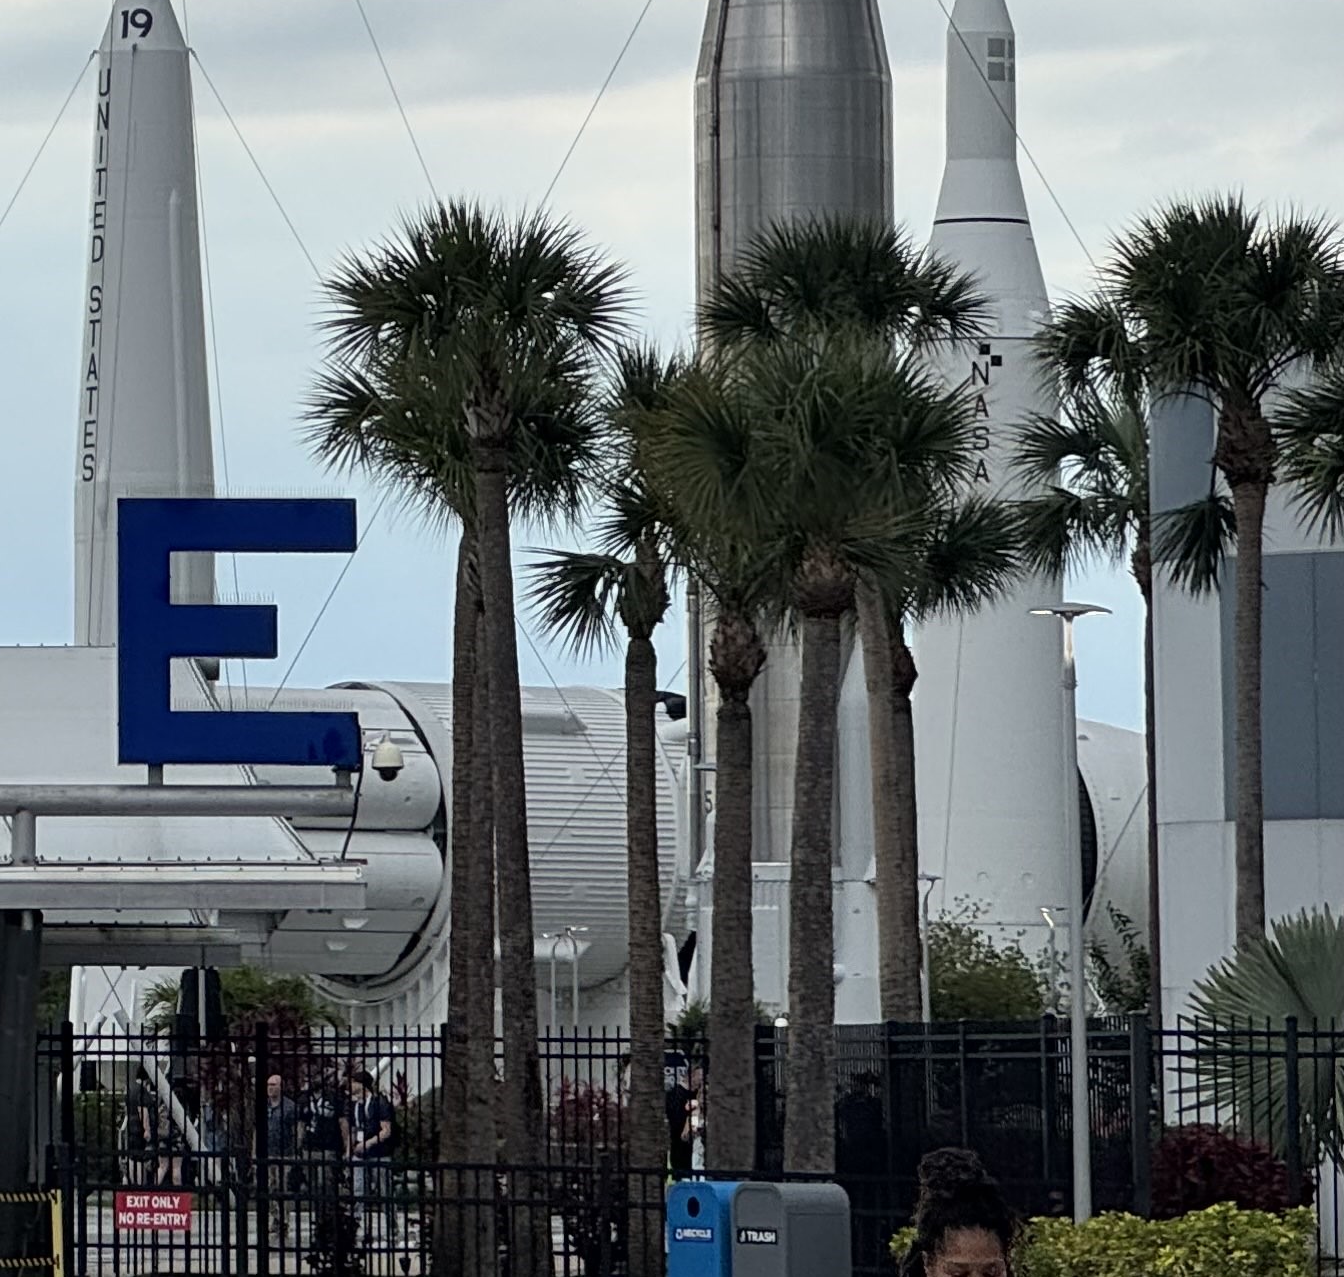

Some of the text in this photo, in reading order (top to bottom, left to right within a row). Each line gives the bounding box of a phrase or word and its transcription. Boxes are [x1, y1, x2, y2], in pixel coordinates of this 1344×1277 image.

[121, 8, 154, 39] 19
[91, 68, 111, 264] UNITED
[82, 285, 103, 482] STATES
[971, 361, 991, 483] NASA
[126, 1195, 181, 1209] EXIT ONLY
[118, 1212, 188, 1226] NO RE-ENTRY
[746, 1230, 776, 1242] TRASH
